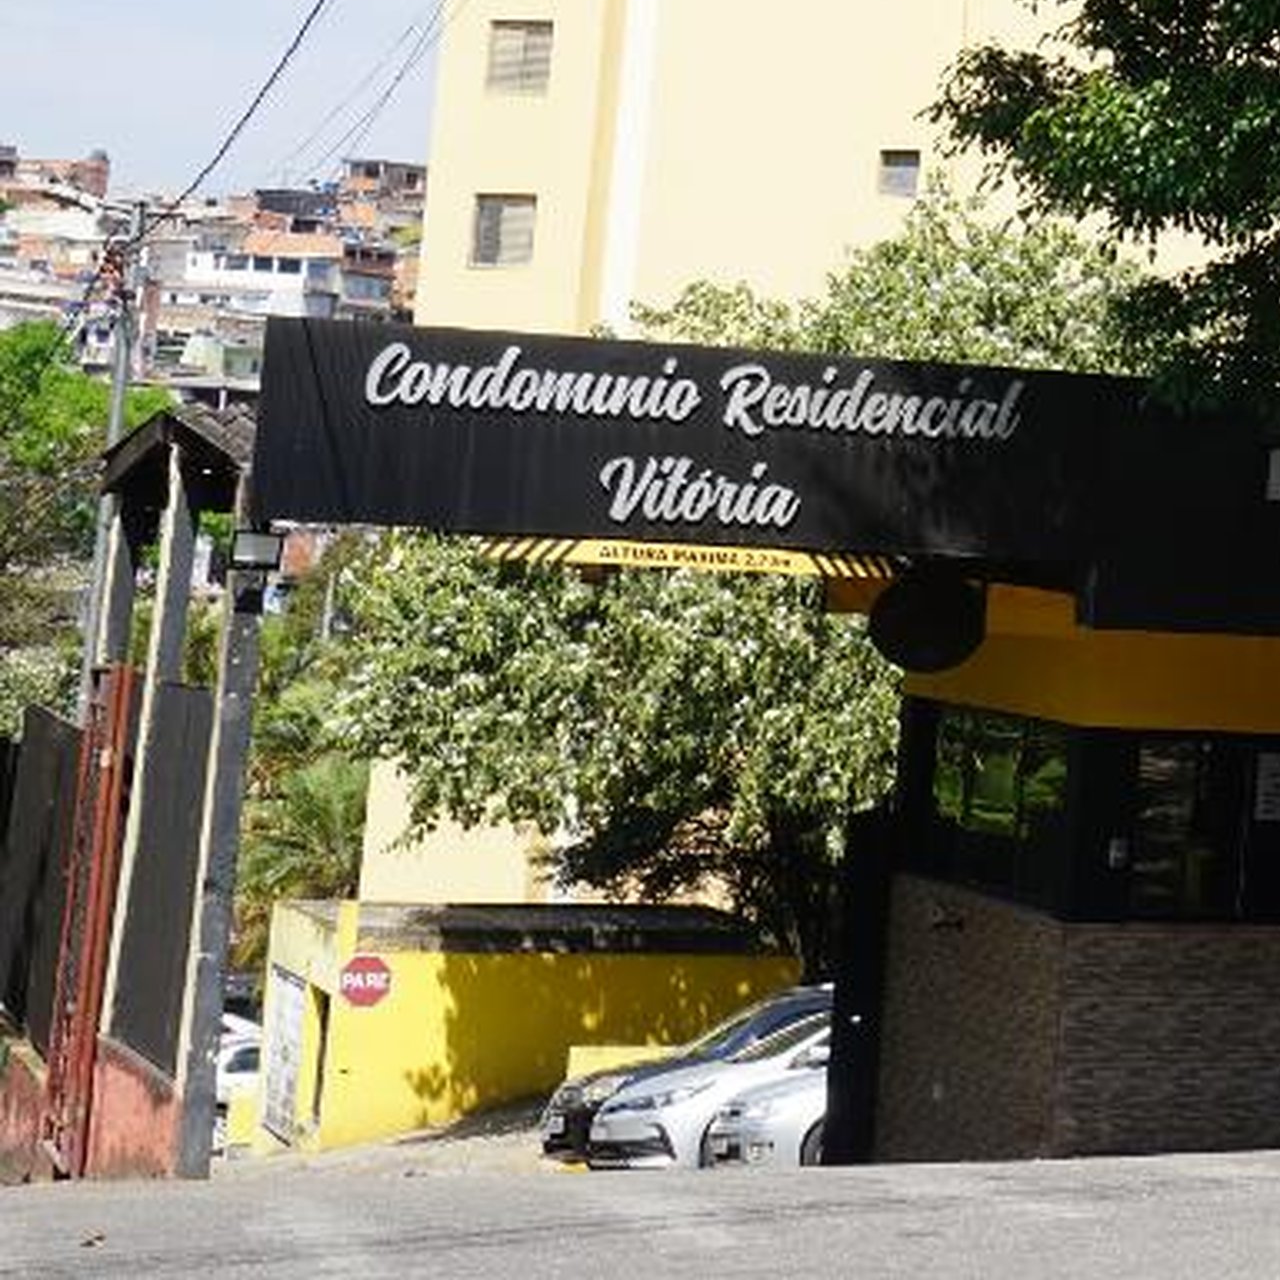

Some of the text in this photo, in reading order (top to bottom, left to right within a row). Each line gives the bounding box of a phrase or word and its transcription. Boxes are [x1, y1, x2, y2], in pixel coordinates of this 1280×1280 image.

[720, 364, 1024, 438] Residencial
[599, 456, 801, 526] Vitória
[599, 546, 668, 562] ALTURA
[343, 972, 388, 989] PARE
